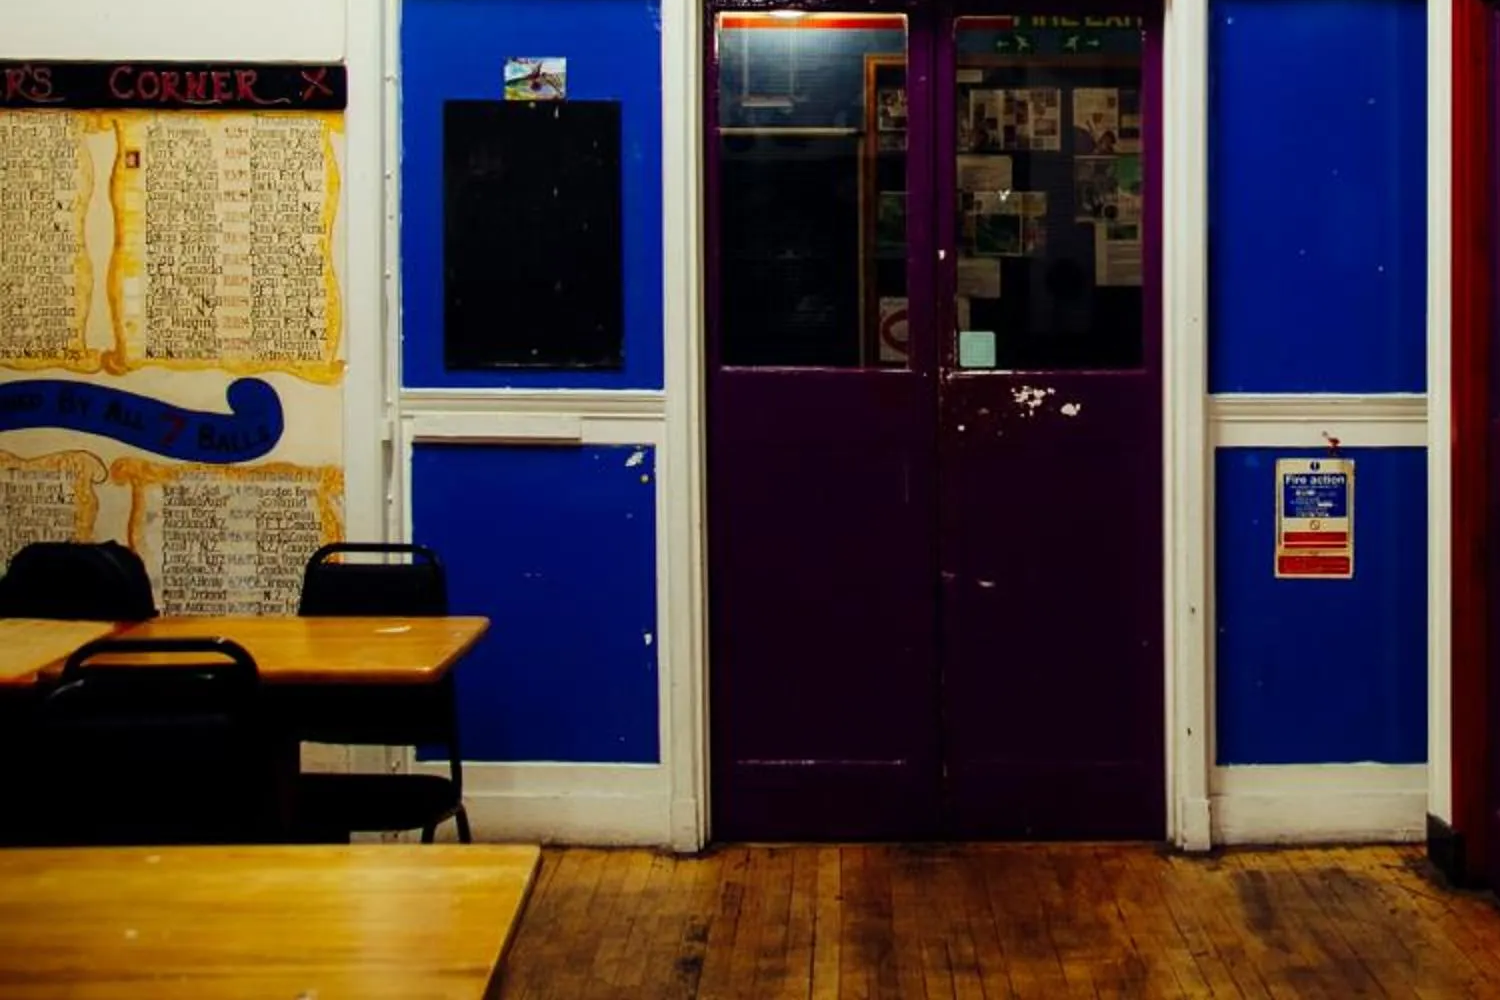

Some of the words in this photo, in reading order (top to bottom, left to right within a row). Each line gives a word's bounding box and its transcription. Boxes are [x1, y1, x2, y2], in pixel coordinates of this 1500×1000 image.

[109, 66, 290, 104] CORNER
[1285, 475, 1307, 485] Fire
[1309, 475, 1345, 486] action
